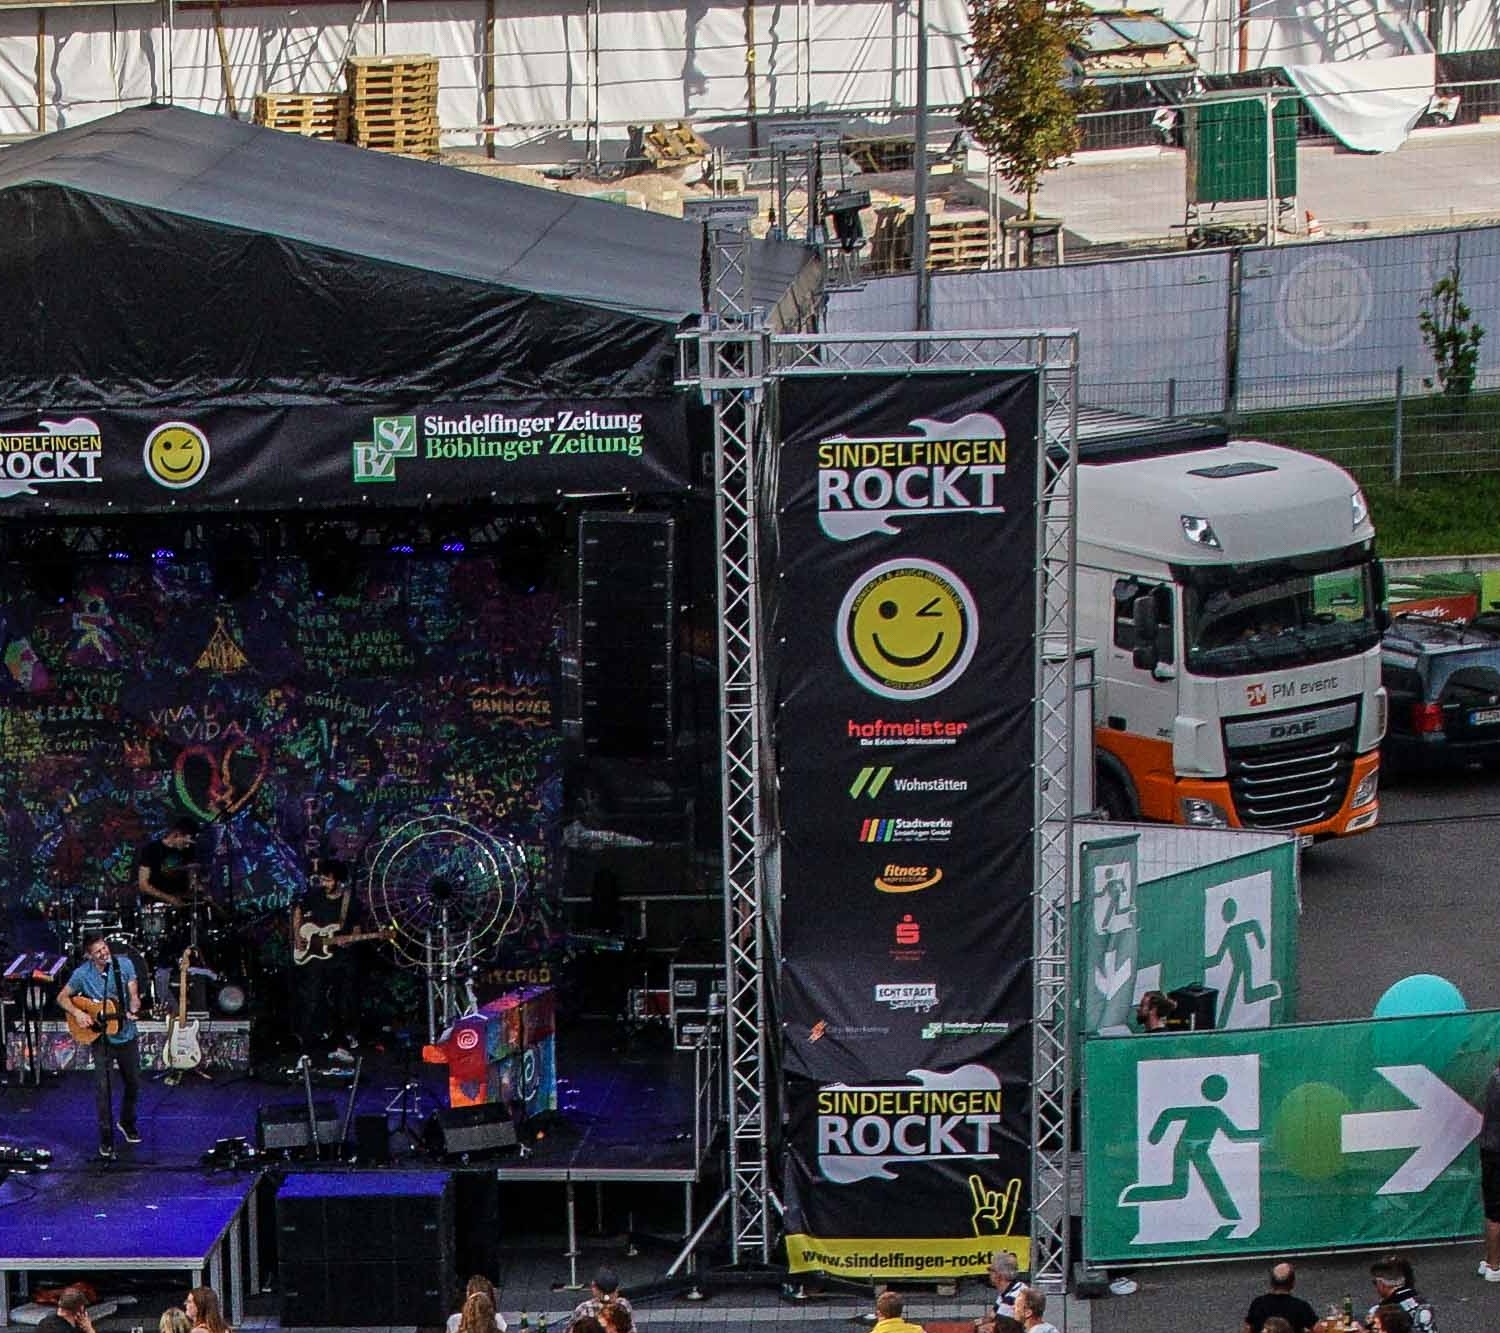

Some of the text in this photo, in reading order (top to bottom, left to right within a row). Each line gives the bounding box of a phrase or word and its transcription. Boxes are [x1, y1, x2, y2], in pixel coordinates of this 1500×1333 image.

[424, 411, 643, 438] Sindelfinger Zeitung
[425, 433, 644, 461] Böblinger Zeitung
[819, 440, 1006, 468] SINDELFINGEN
[819, 464, 1006, 510] ROCKT
[1272, 680, 1295, 698] PM
[1301, 675, 1339, 695] event
[848, 719, 968, 737] hofmeister
[1269, 720, 1318, 738] DAF
[894, 778, 968, 792] Wohnstätten
[896, 818, 953, 829] Stadtwerke
[884, 864, 929, 877] fitness
[818, 1091, 1001, 1115] SINDELFINGEN
[818, 1114, 1000, 1155] ROCKT
